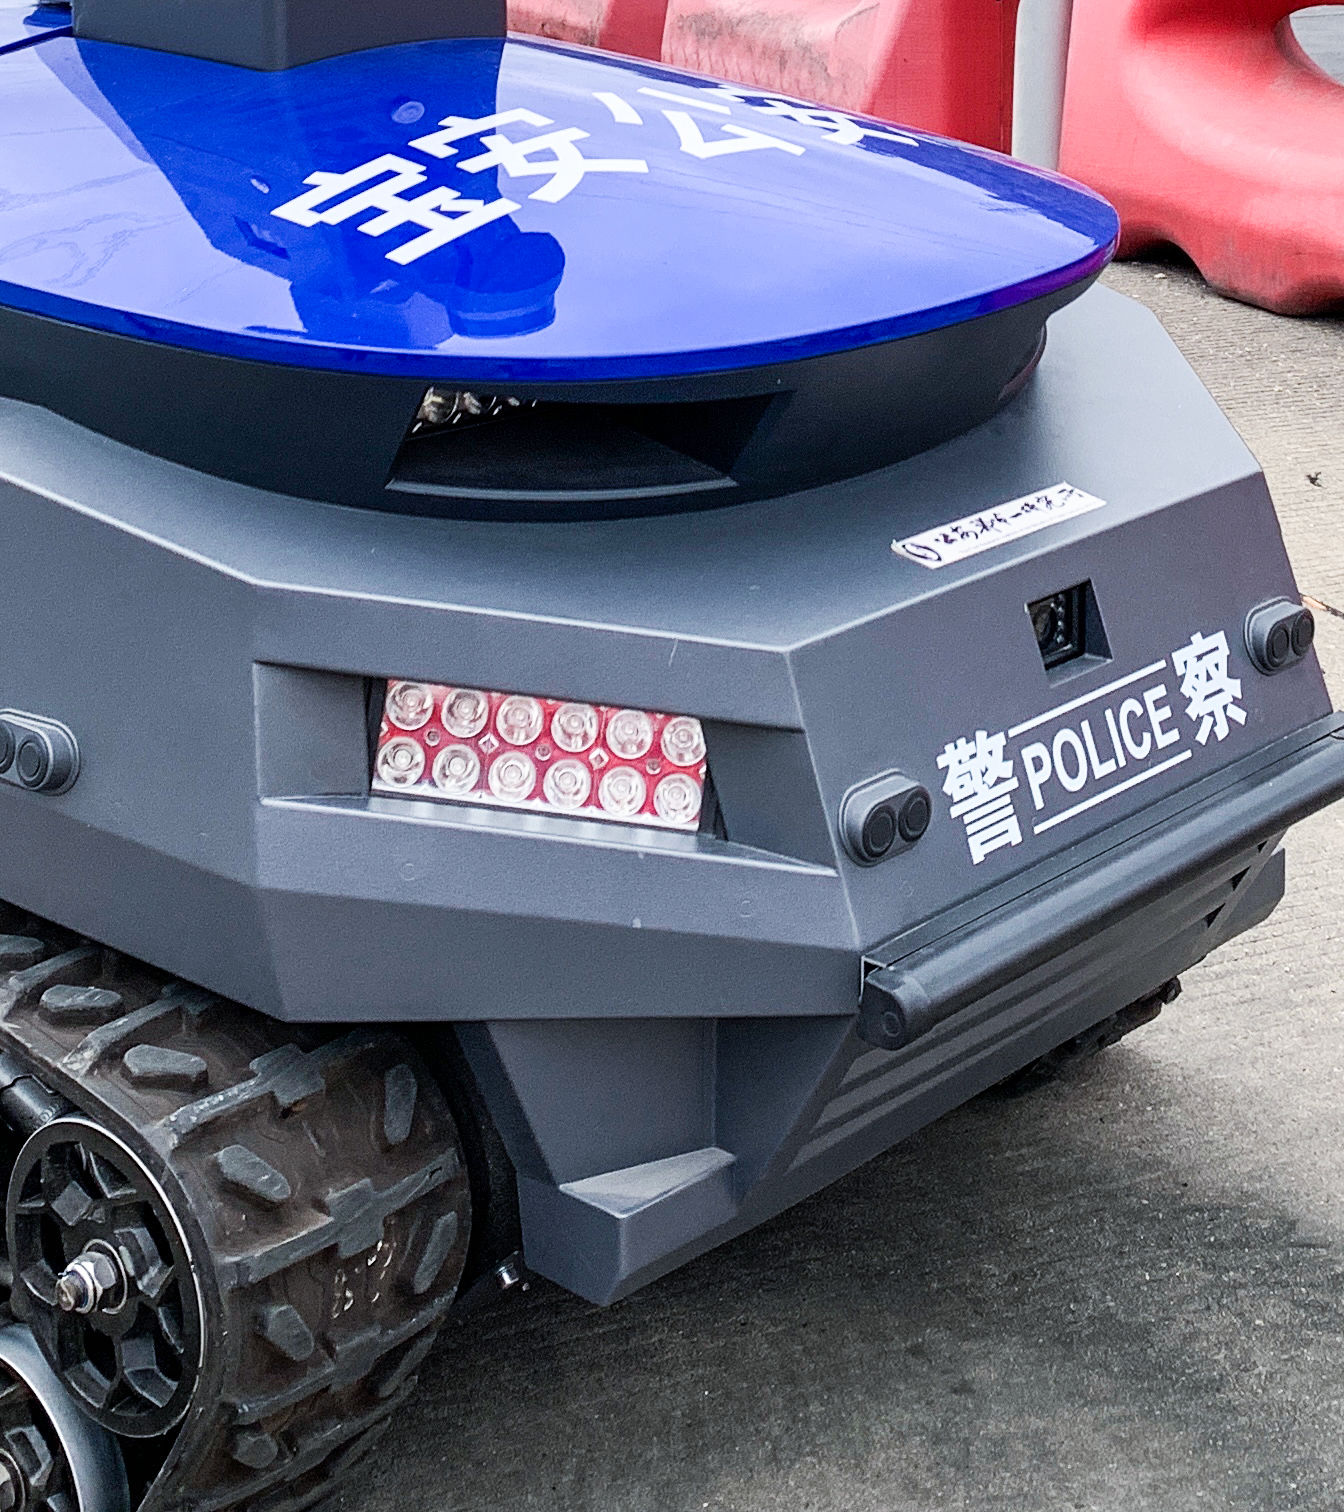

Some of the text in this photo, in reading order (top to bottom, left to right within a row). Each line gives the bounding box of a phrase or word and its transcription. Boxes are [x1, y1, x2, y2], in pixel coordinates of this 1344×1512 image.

[936, 630, 1248, 865] 警 POLICE 察
